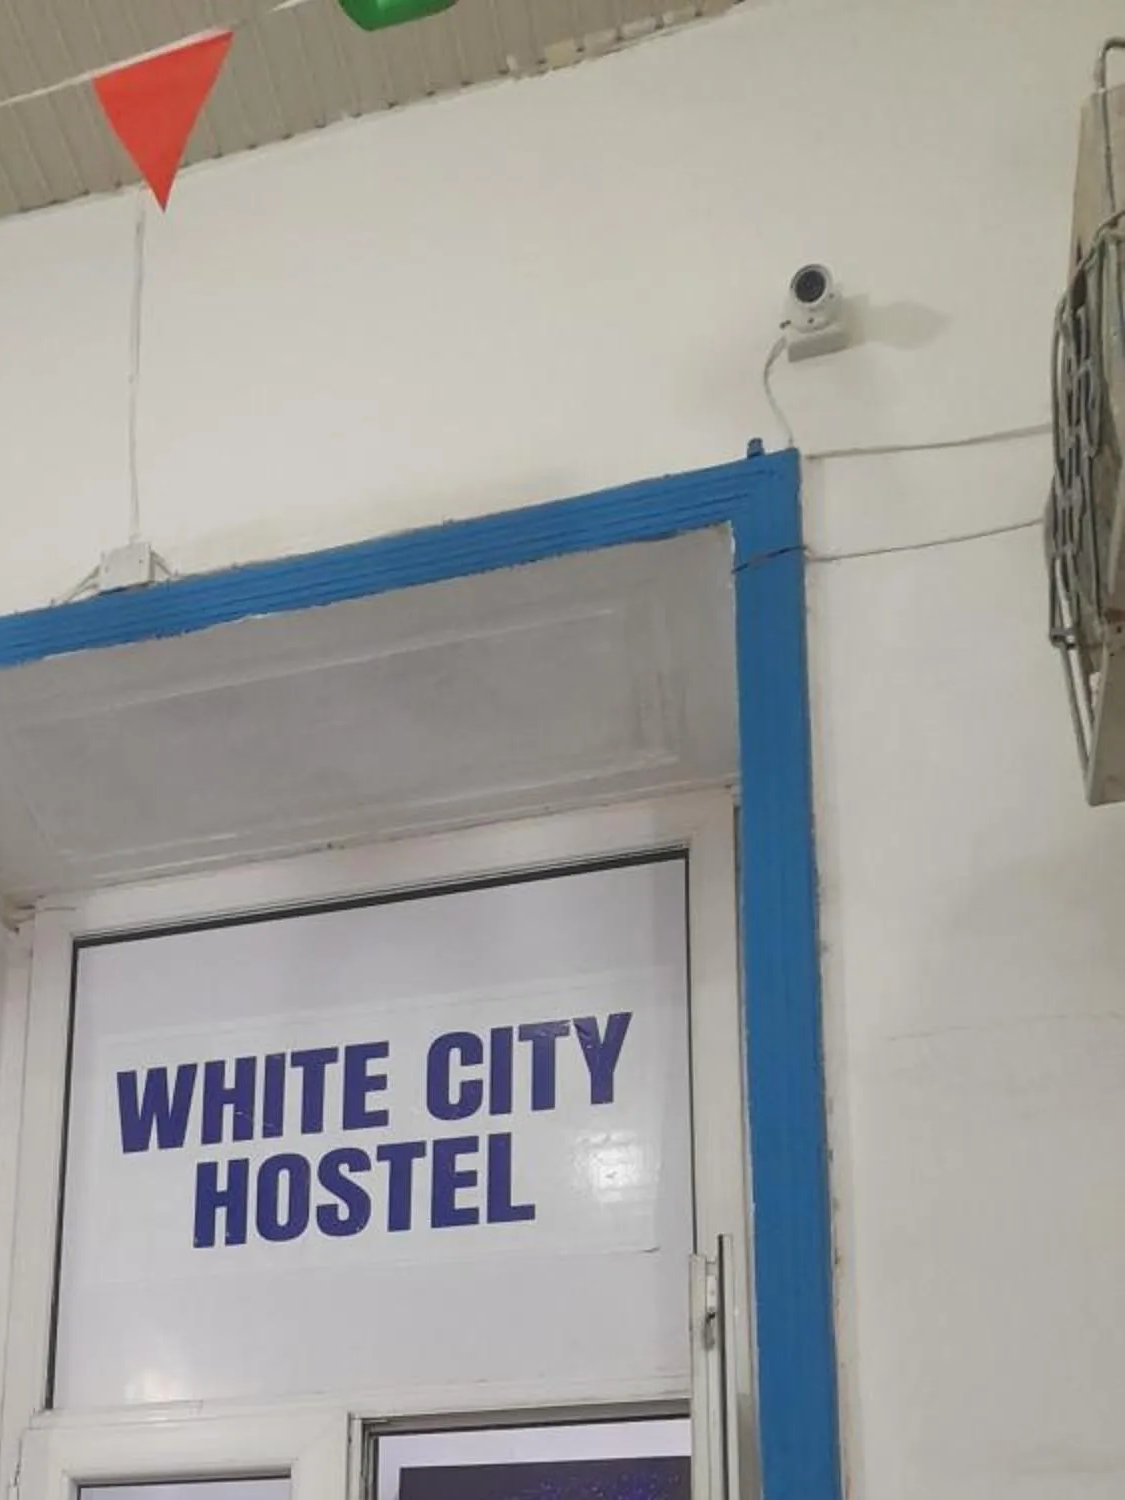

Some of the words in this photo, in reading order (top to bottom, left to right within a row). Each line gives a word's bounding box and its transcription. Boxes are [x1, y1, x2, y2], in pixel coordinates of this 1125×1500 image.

[116, 1040, 389, 1153] WHITE
[426, 1011, 633, 1120] CITY
[193, 1131, 536, 1248] HOSTEL
